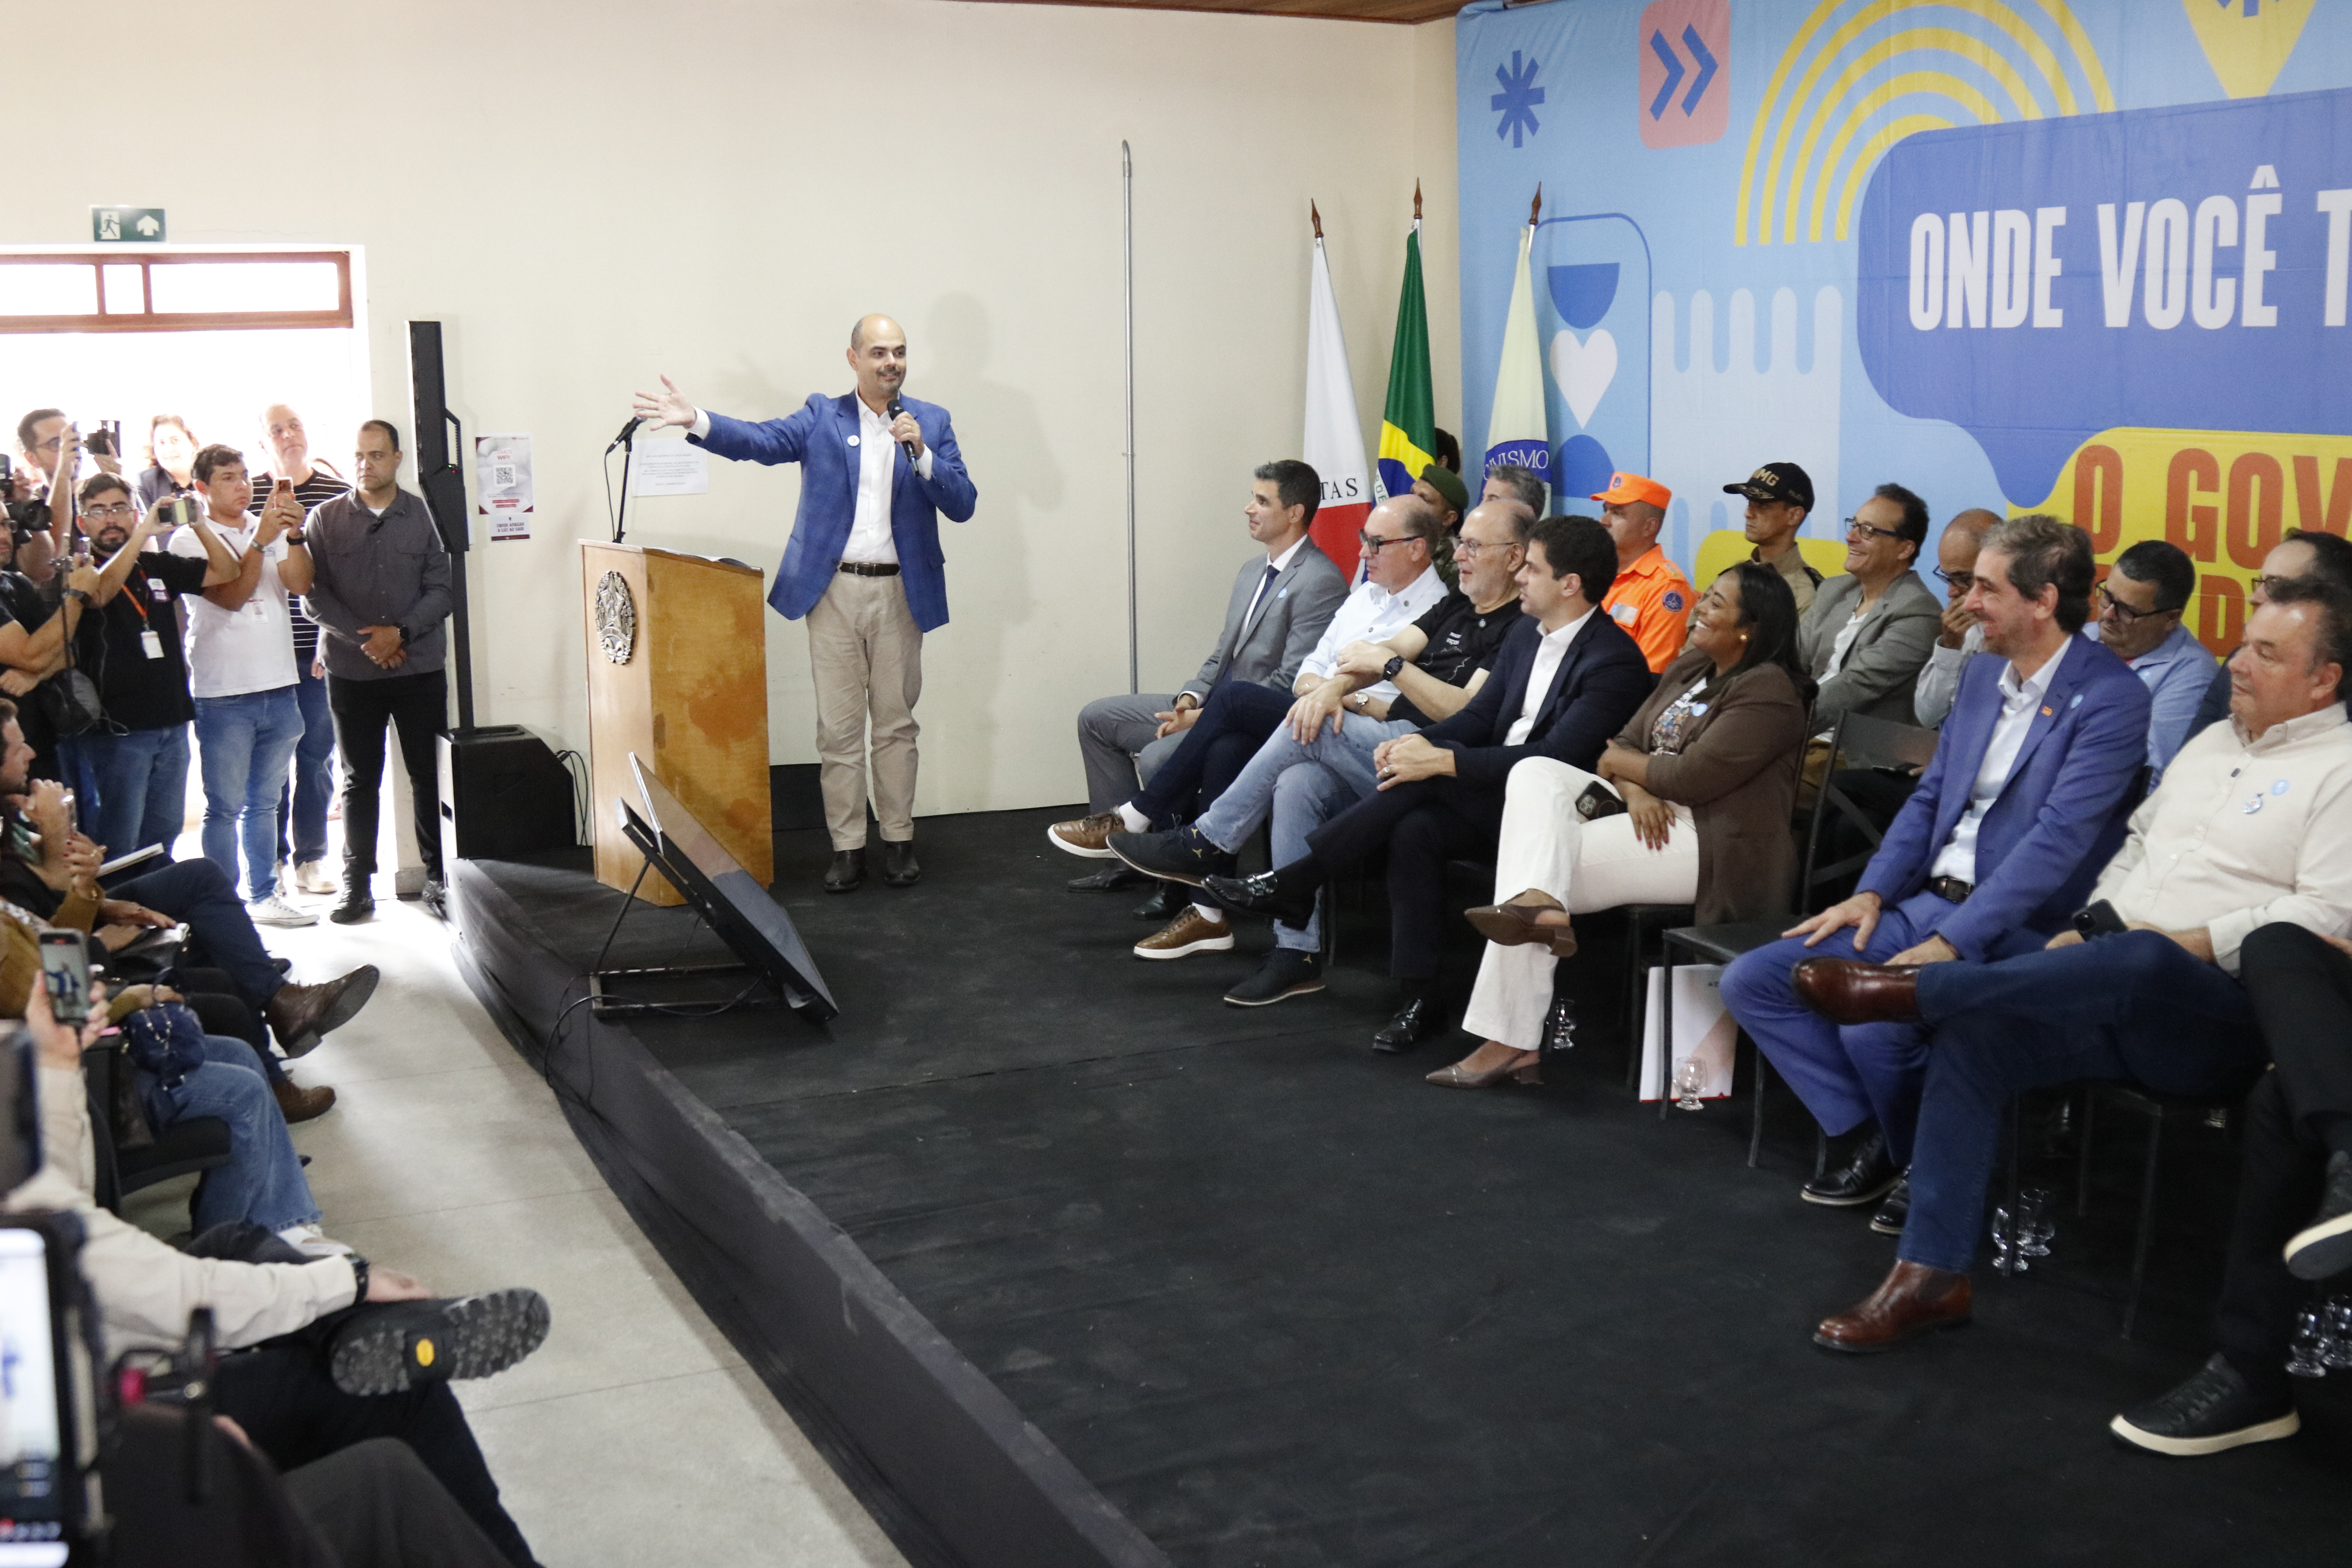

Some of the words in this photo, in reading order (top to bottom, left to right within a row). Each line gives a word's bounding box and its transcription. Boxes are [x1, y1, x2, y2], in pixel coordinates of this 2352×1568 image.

[1909, 206, 2067, 331] ONDE
[2097, 164, 2283, 330] VOCÊ
[1319, 477, 1358, 500] TAS
[2073, 445, 2123, 554] O
